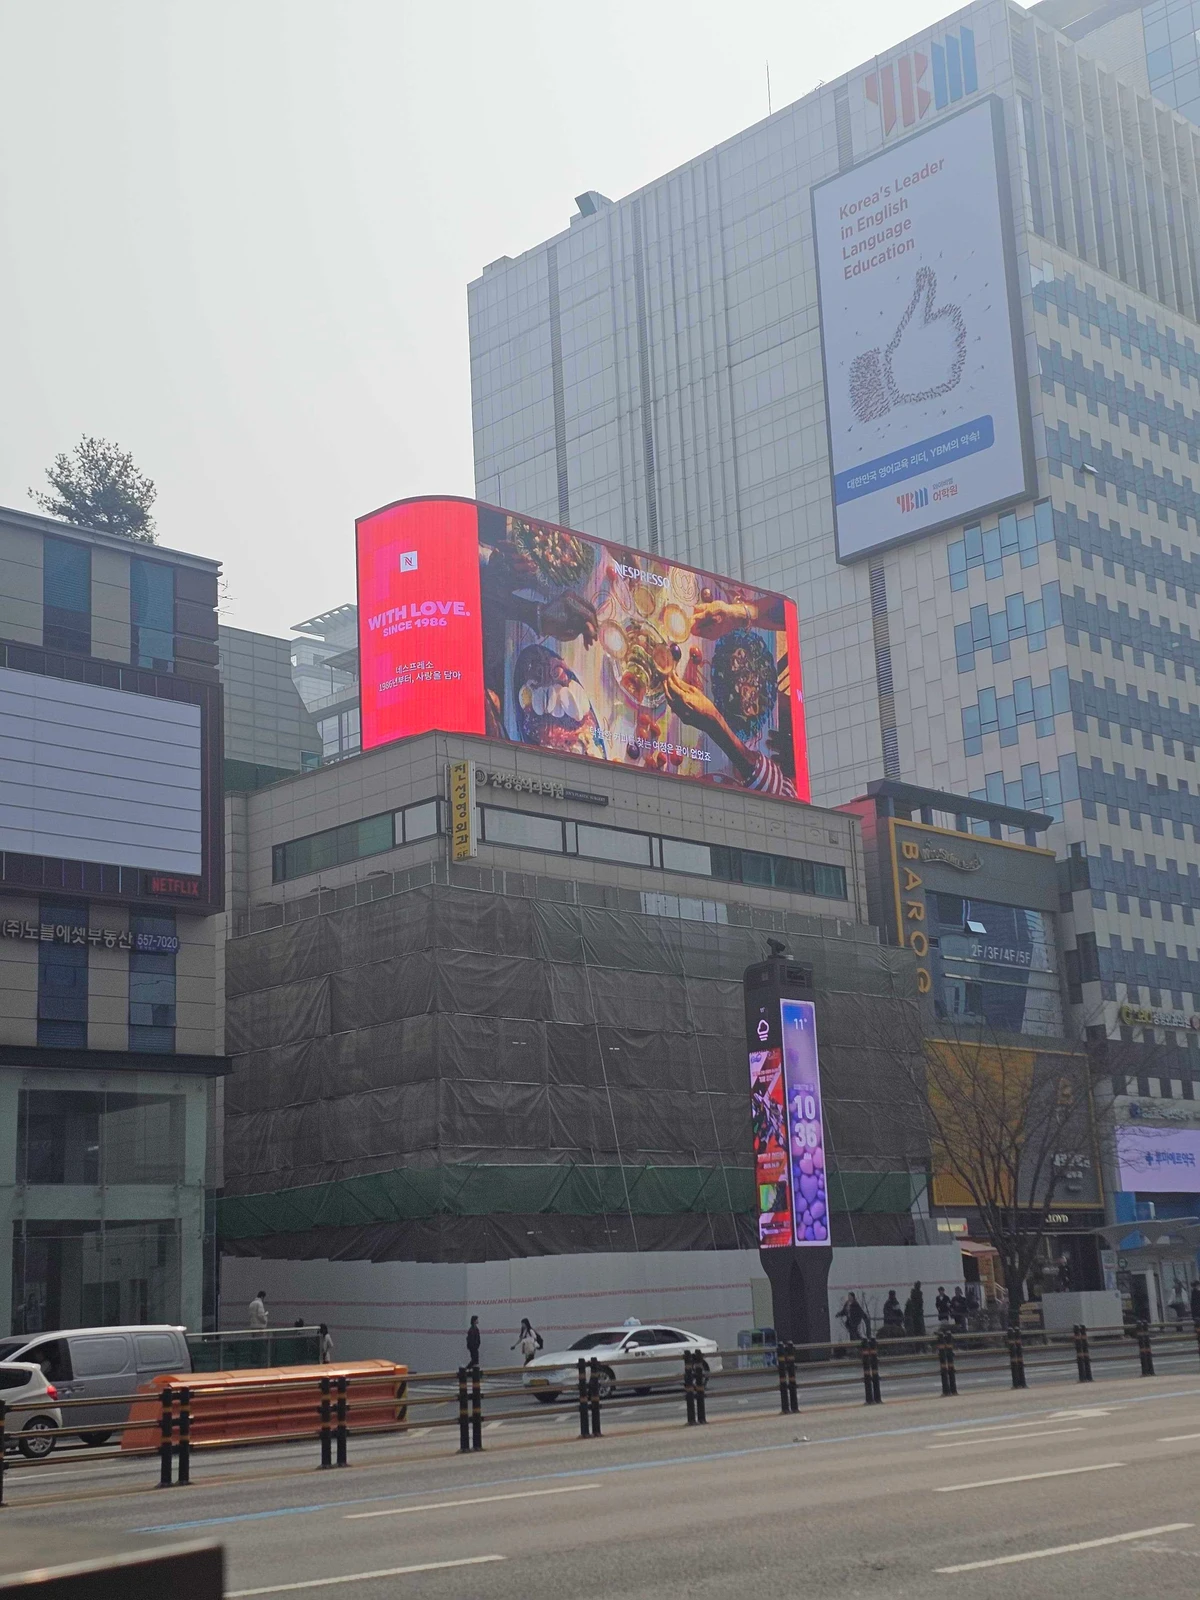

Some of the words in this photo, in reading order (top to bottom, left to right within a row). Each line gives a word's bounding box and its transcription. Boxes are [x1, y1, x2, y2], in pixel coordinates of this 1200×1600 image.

[865, 25, 978, 137] YBM
[839, 186, 891, 220] Korea's
[895, 158, 945, 193] Leader
[840, 226, 853, 240] in
[857, 197, 908, 233] English
[842, 218, 912, 260] Language
[843, 238, 915, 280] Education
[846, 472, 877, 489] 대한민국
[878, 458, 909, 478] 영어교육
[910, 451, 929, 465] 리더,
[930, 438, 959, 458] YBM의
[960, 431, 980, 445] 약속!
[932, 484, 958, 501] 어학원
[612, 558, 670, 588] NESPRESSO
[368, 605, 407, 631] WITH
[410, 601, 471, 618] LOVE.
[383, 620, 413, 637] SINCE
[414, 617, 447, 628] 1986
[379, 674, 415, 692] 1986년부터,
[416, 670, 442, 681] 사랑을
[444, 670, 461, 680] 담아
[395, 660, 434, 674] 네스프레소
[636, 737, 652, 749] 찾는
[652, 740, 674, 755] 여정은
[675, 745, 689, 758] 끝이
[152, 877, 199, 896] NETFLIX
[2, 918, 133, 950] (주)노블에셋부동산
[137, 933, 178, 949] 557-7020
[794, 1095, 816, 1120] 10
[794, 1122, 817, 1148] 36
